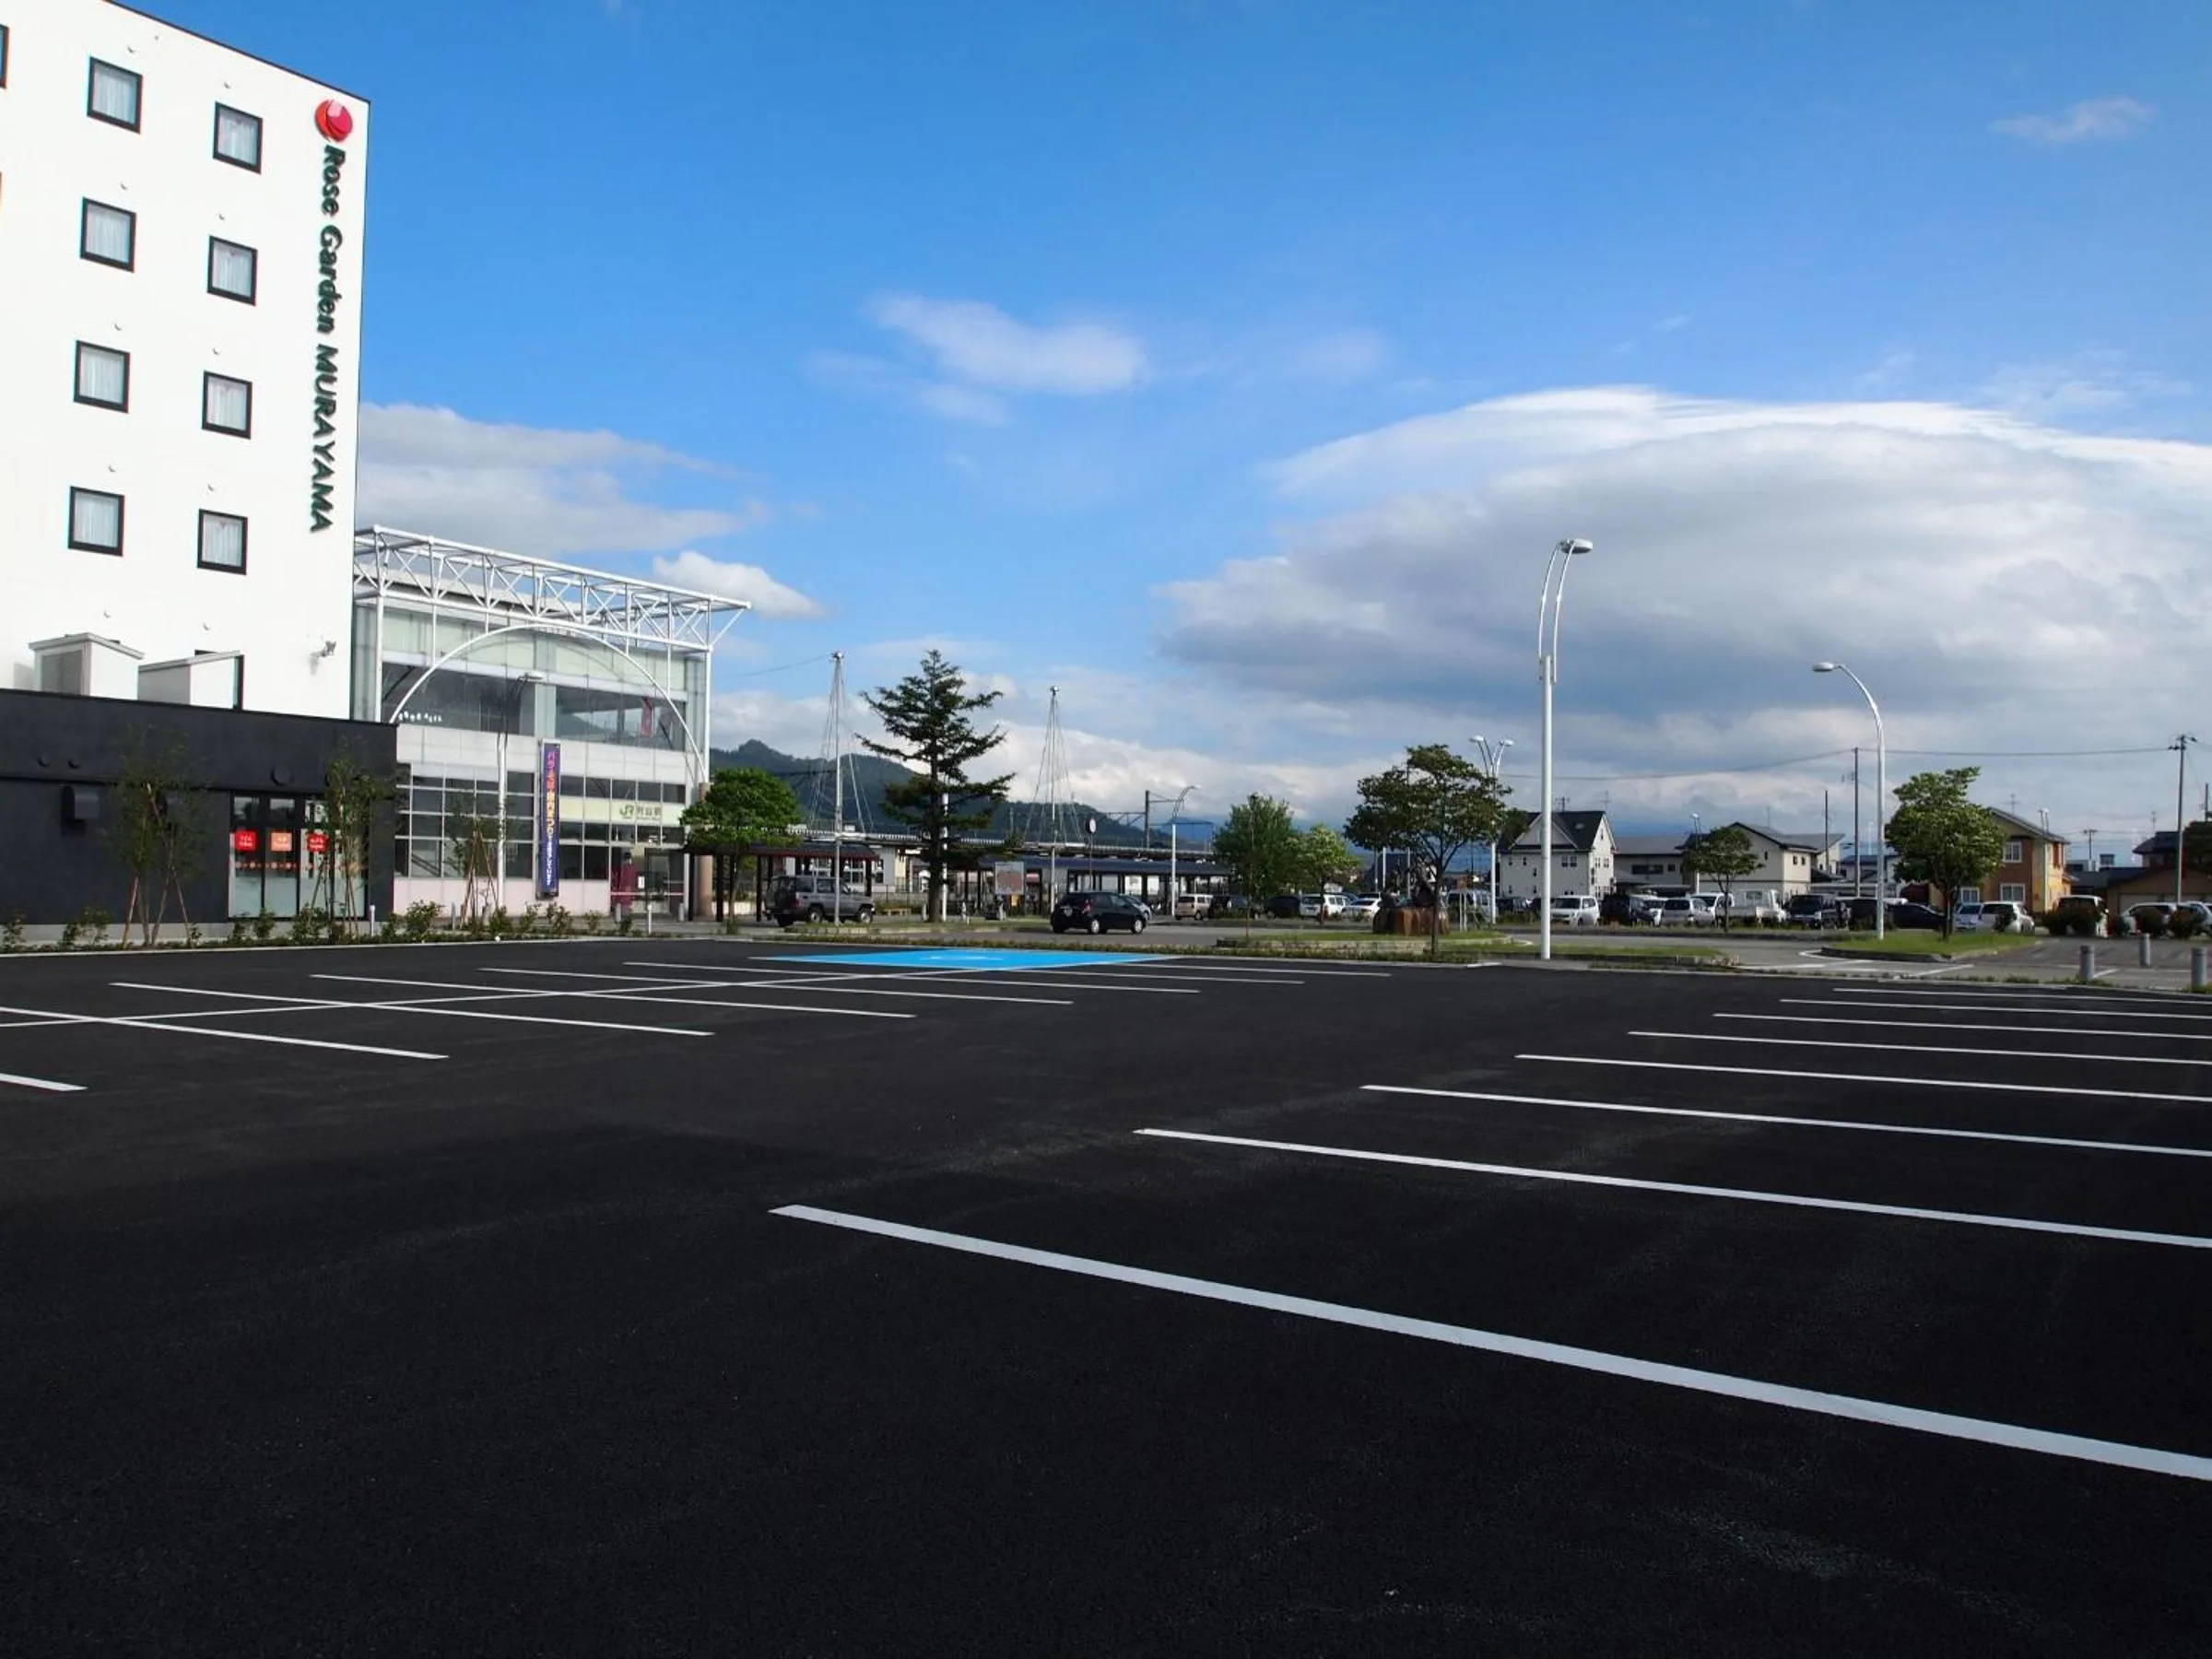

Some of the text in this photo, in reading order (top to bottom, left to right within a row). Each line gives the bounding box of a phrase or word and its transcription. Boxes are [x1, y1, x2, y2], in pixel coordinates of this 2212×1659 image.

[310, 145, 347, 533] Rose Garden MURAYAMA
